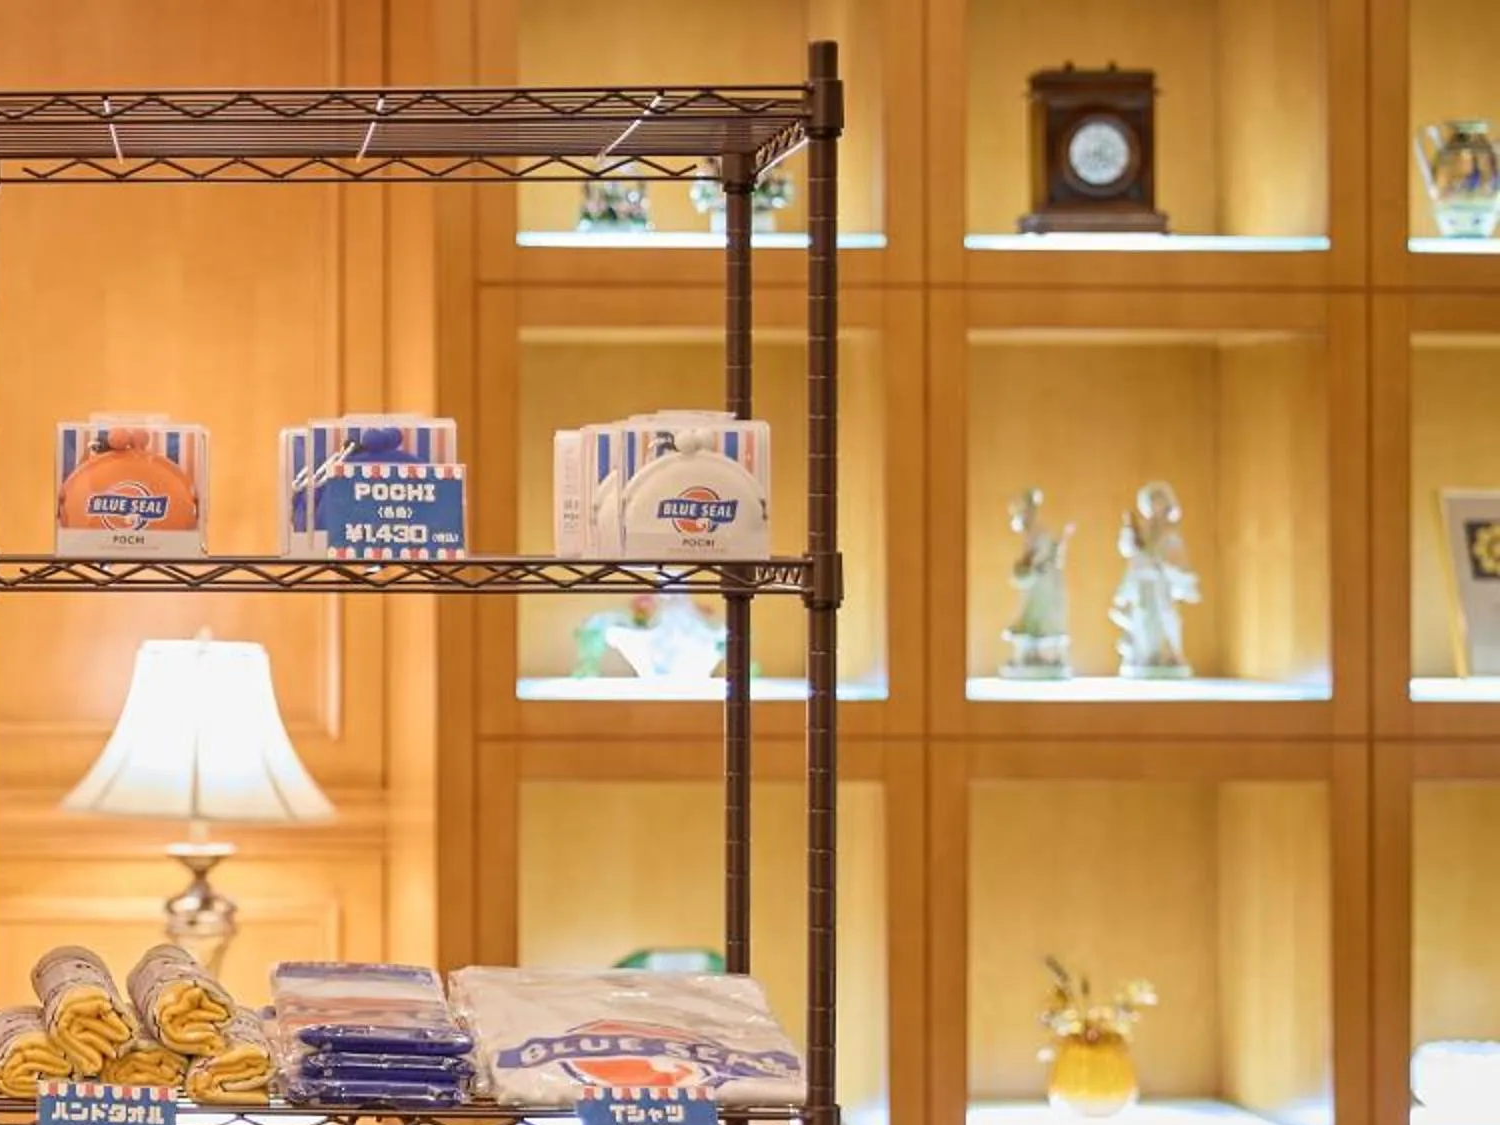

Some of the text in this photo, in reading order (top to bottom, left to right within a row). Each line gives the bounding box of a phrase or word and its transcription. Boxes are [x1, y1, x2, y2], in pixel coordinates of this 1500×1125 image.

[354, 483, 436, 501] POCHI
[93, 498, 163, 514] BLUE SEAL
[663, 502, 732, 517] BLUE SEAL
[51, 1101, 165, 1125] ハンドタオル
